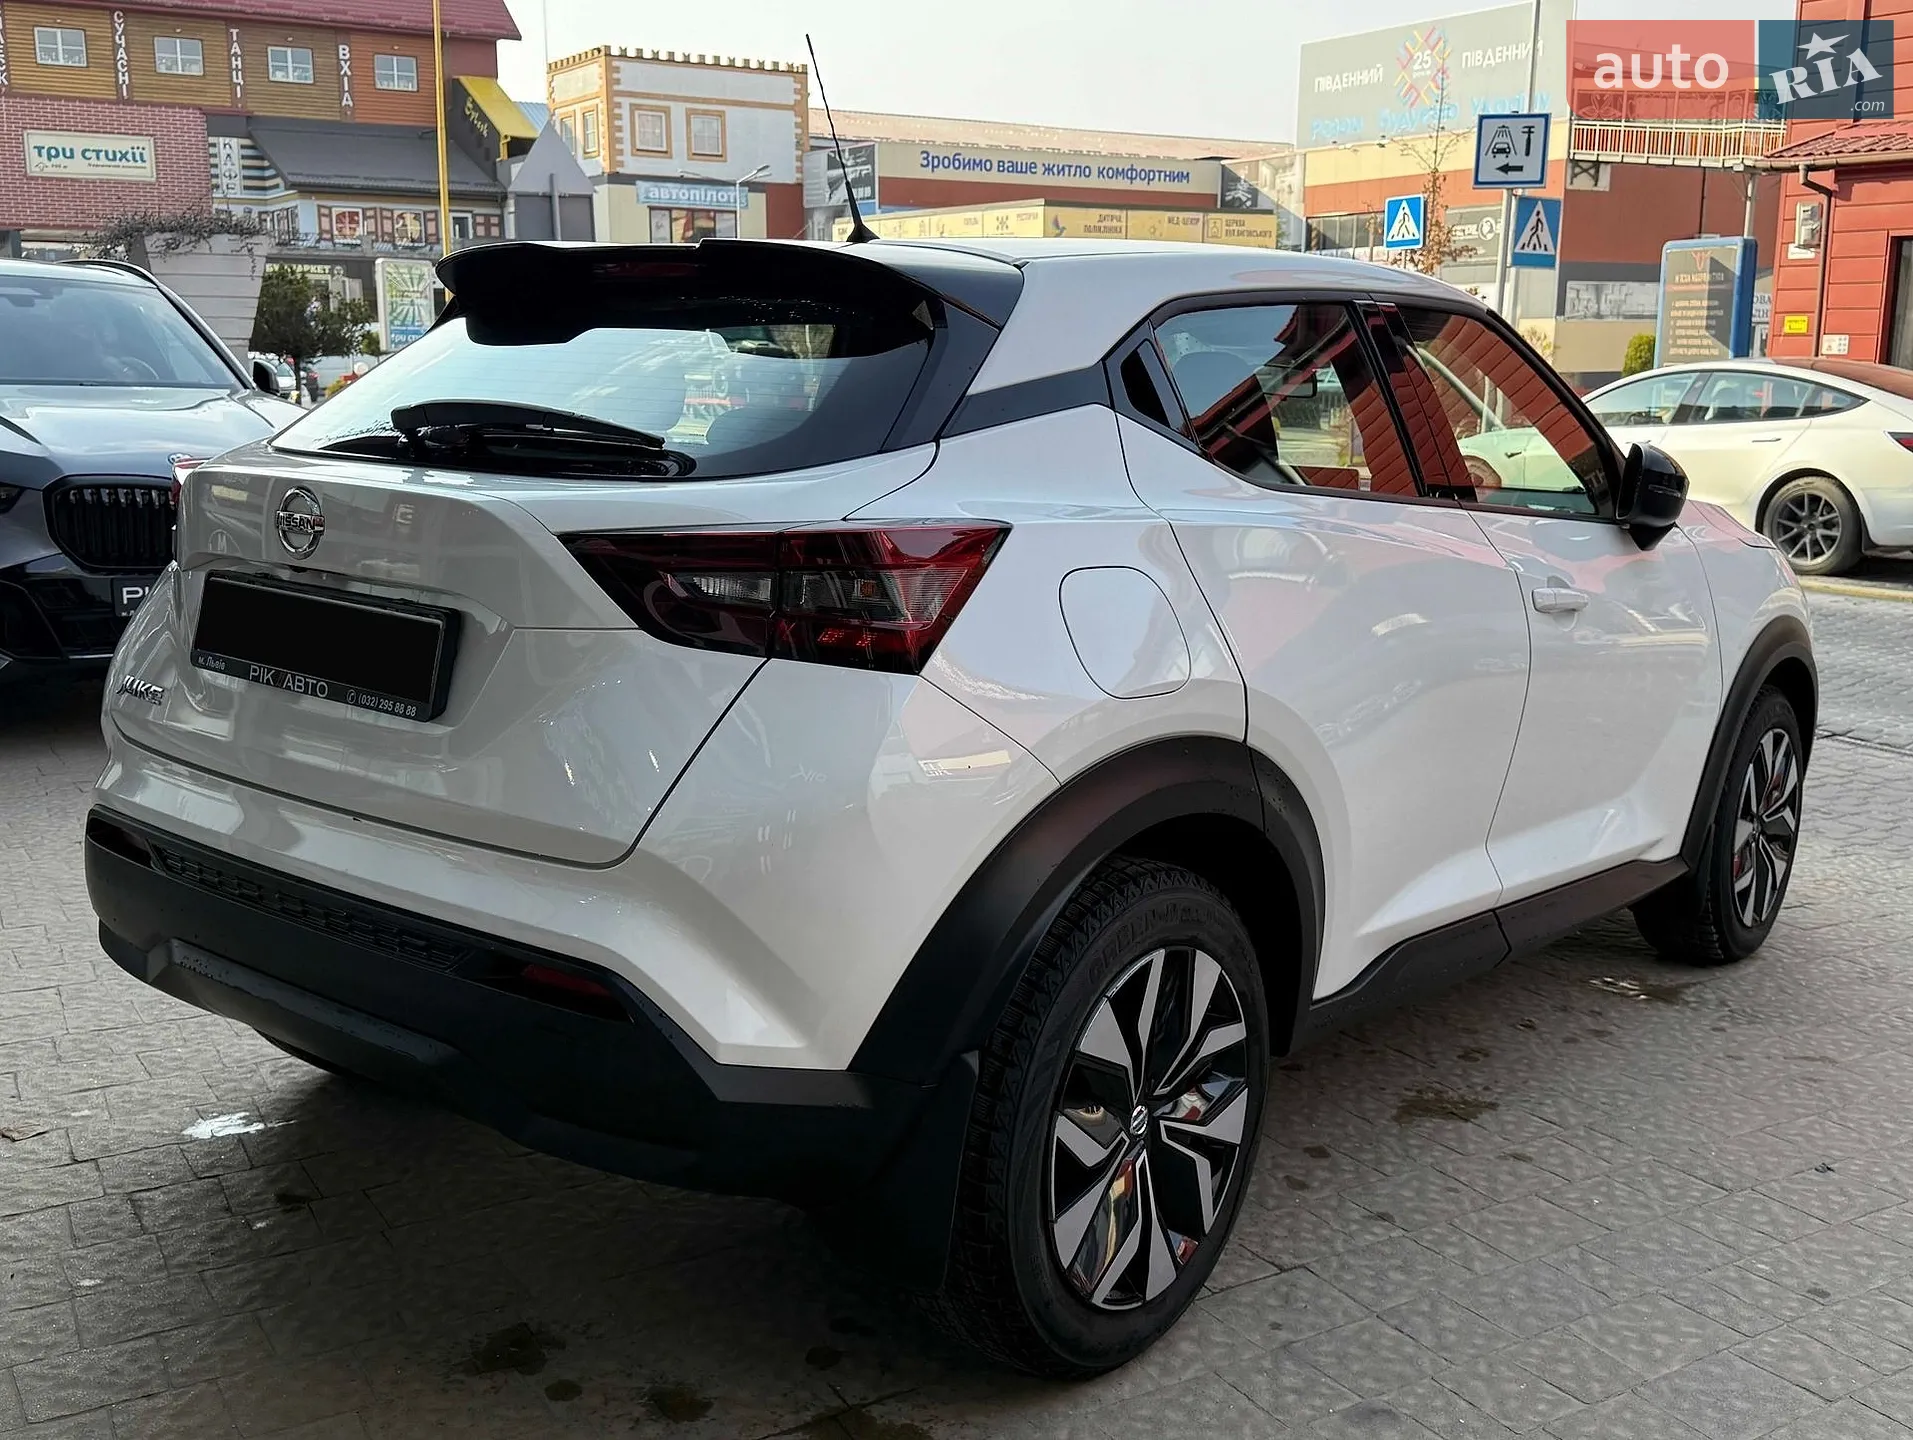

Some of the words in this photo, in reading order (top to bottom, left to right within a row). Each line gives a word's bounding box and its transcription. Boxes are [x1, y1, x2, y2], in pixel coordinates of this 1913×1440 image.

[113, 10, 129, 100] СУЧАСНІ
[1412, 49, 1432, 70] 25
[1314, 63, 1384, 93] ПІВДЕННИЙ
[33, 145, 75, 162] три
[80, 146, 147, 163] стихії
[920, 150, 993, 173] Зробимо
[996, 160, 1038, 175] ваше
[1042, 162, 1092, 178] житло
[1097, 164, 1191, 185] комфортним
[649, 186, 737, 204] автопілот
[249, 664, 276, 686] РІК
[283, 673, 329, 698] АВТО
[358, 693, 379, 709] (032)
[379, 698, 394, 712] 295
[394, 702, 405, 715] 88
[405, 705, 417, 718] 88
